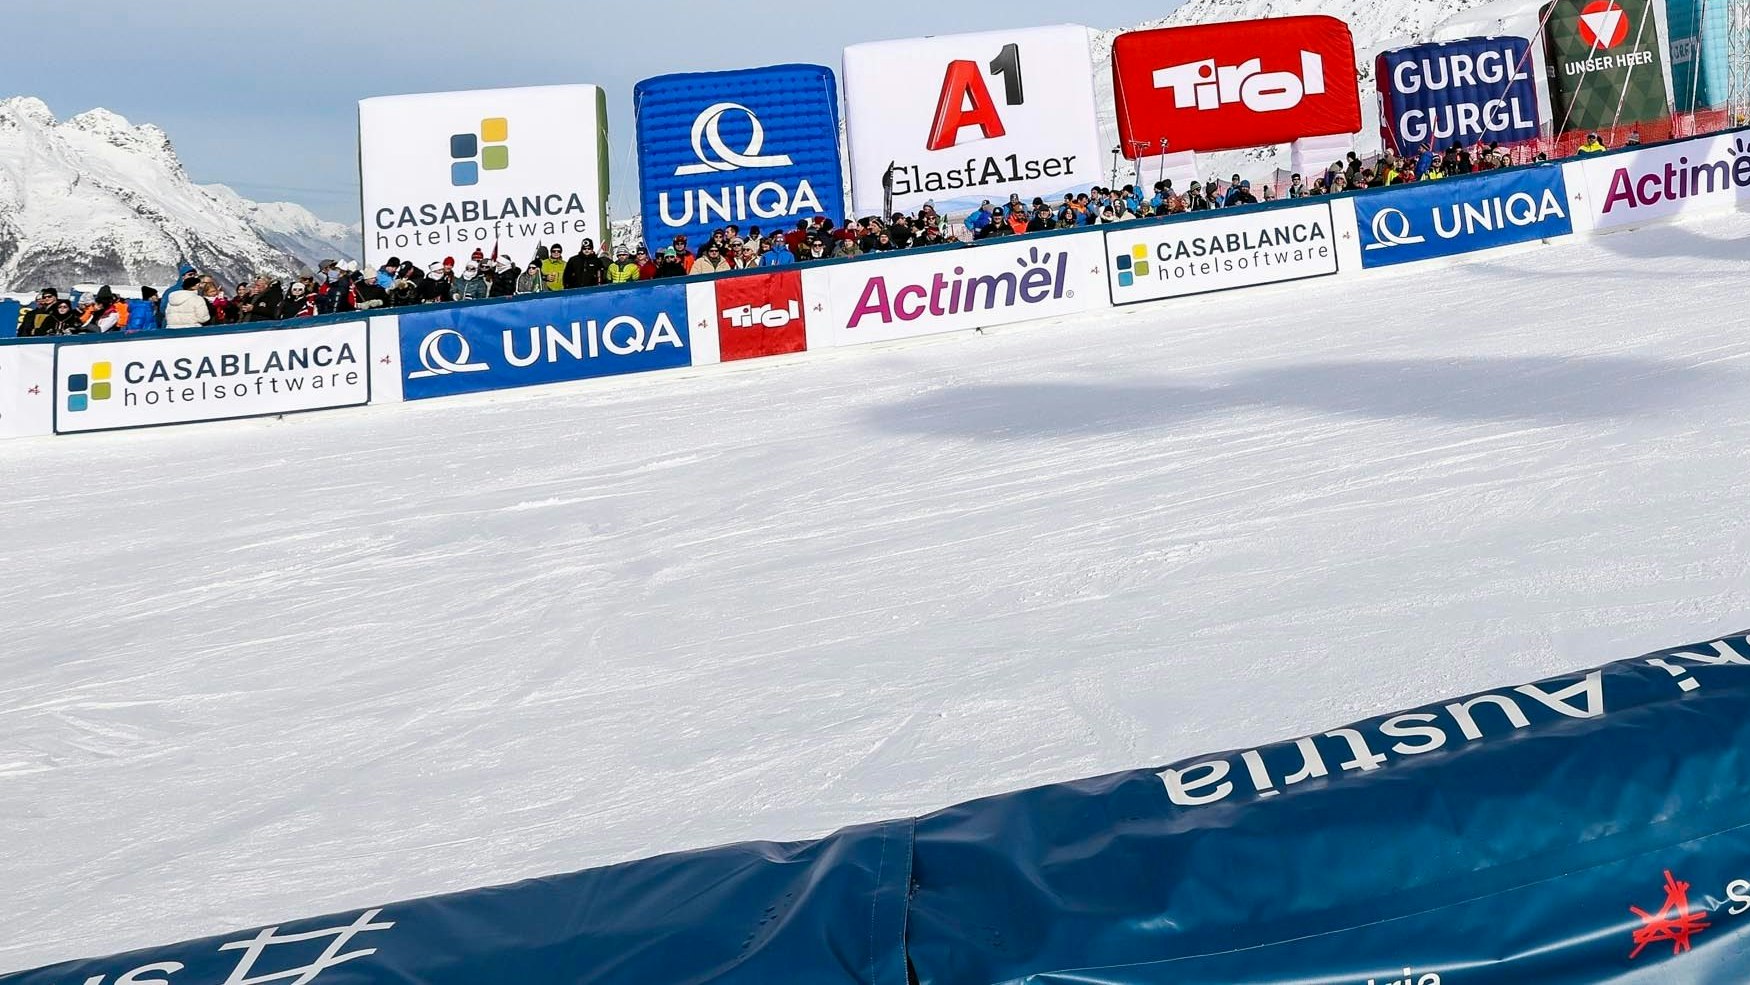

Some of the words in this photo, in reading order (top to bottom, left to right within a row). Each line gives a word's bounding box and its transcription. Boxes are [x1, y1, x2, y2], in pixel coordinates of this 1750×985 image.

[1152, 50, 1325, 113] Tirol
[1393, 48, 1528, 94] GURGL
[1565, 55, 1613, 77] UNSER
[1616, 50, 1653, 68] HEER
[926, 43, 1025, 152] A1
[1400, 96, 1534, 143] GURGL
[889, 153, 1076, 196] GlasfA1ser
[376, 193, 585, 230] CASABLANCA
[659, 178, 825, 228] UNIQA
[1432, 188, 1565, 240] UNIQA
[376, 219, 586, 250] hotelsoftware
[1156, 221, 1325, 262] CASABLANCA
[1158, 244, 1329, 281] hotelsoftware
[722, 299, 800, 329] Tirol
[503, 312, 684, 368] UNIQA
[124, 341, 358, 384] CASABLANCA
[124, 368, 359, 407] hotelsoftware
[1156, 670, 1604, 806] Austria
